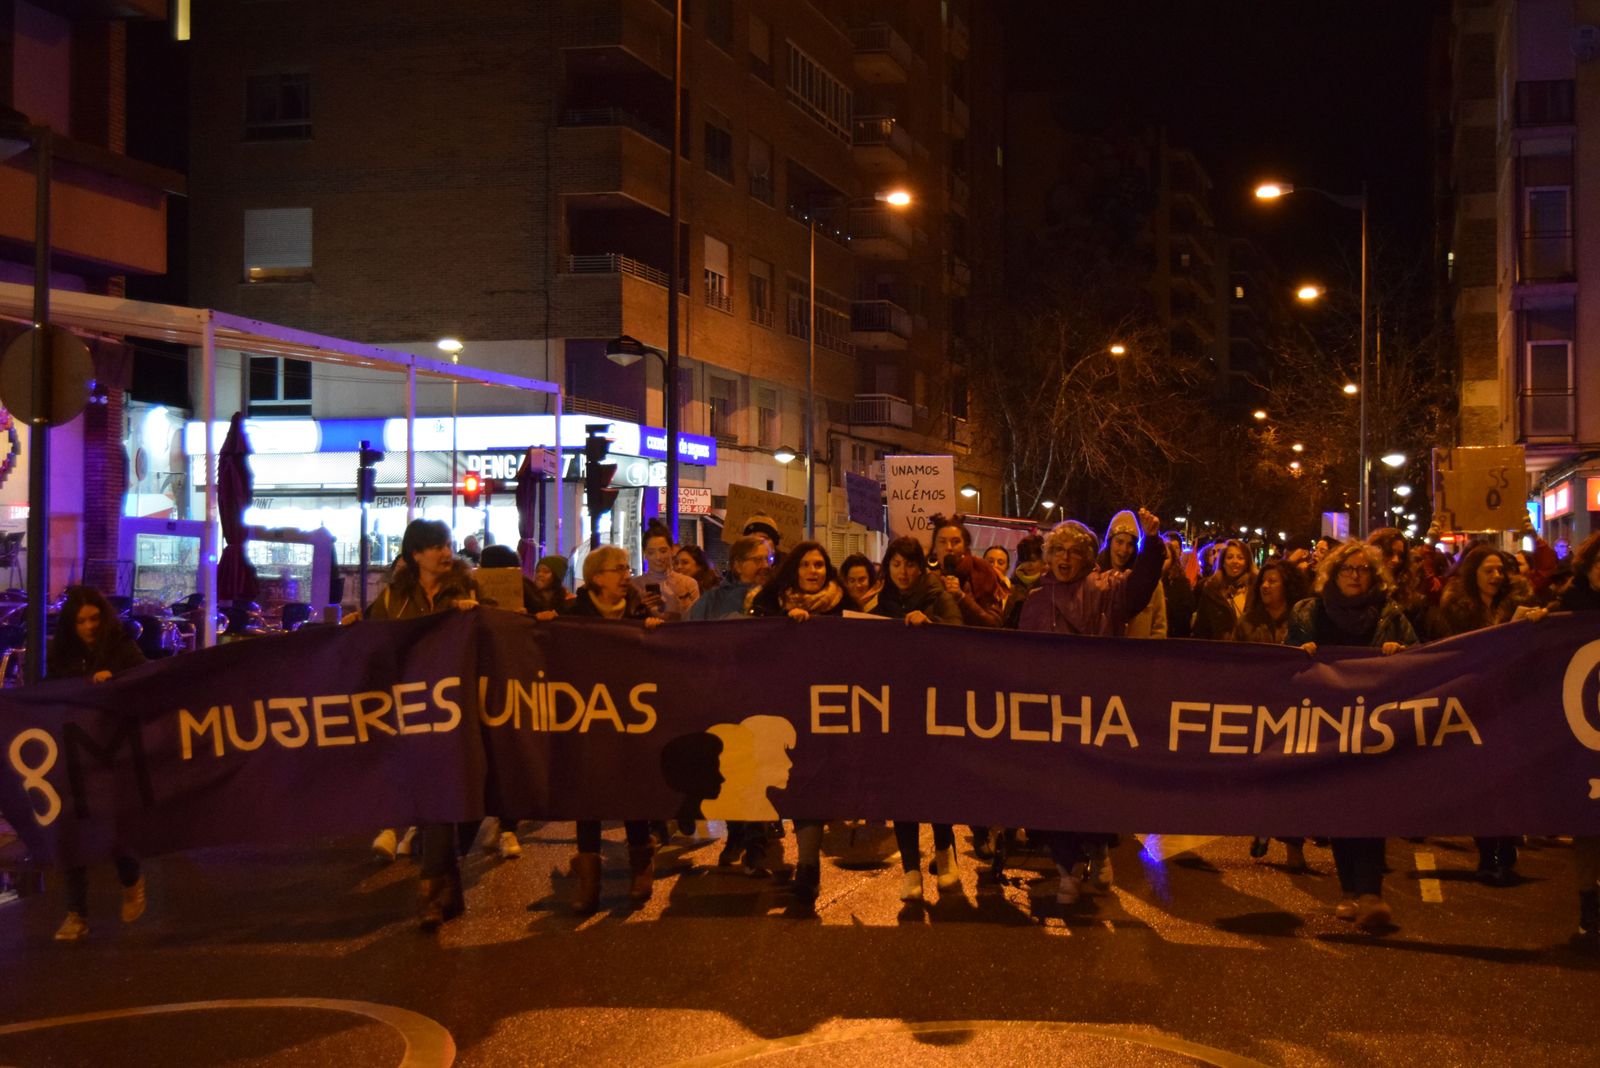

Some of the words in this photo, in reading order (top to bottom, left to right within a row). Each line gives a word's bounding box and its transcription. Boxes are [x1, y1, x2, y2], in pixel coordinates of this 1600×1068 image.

[891, 464, 940, 477] UNAMOS
[678, 487, 709, 498] LQUILA
[177, 675, 462, 761] MUJERES
[809, 684, 892, 736] EN
[925, 687, 1139, 750] LUCHA
